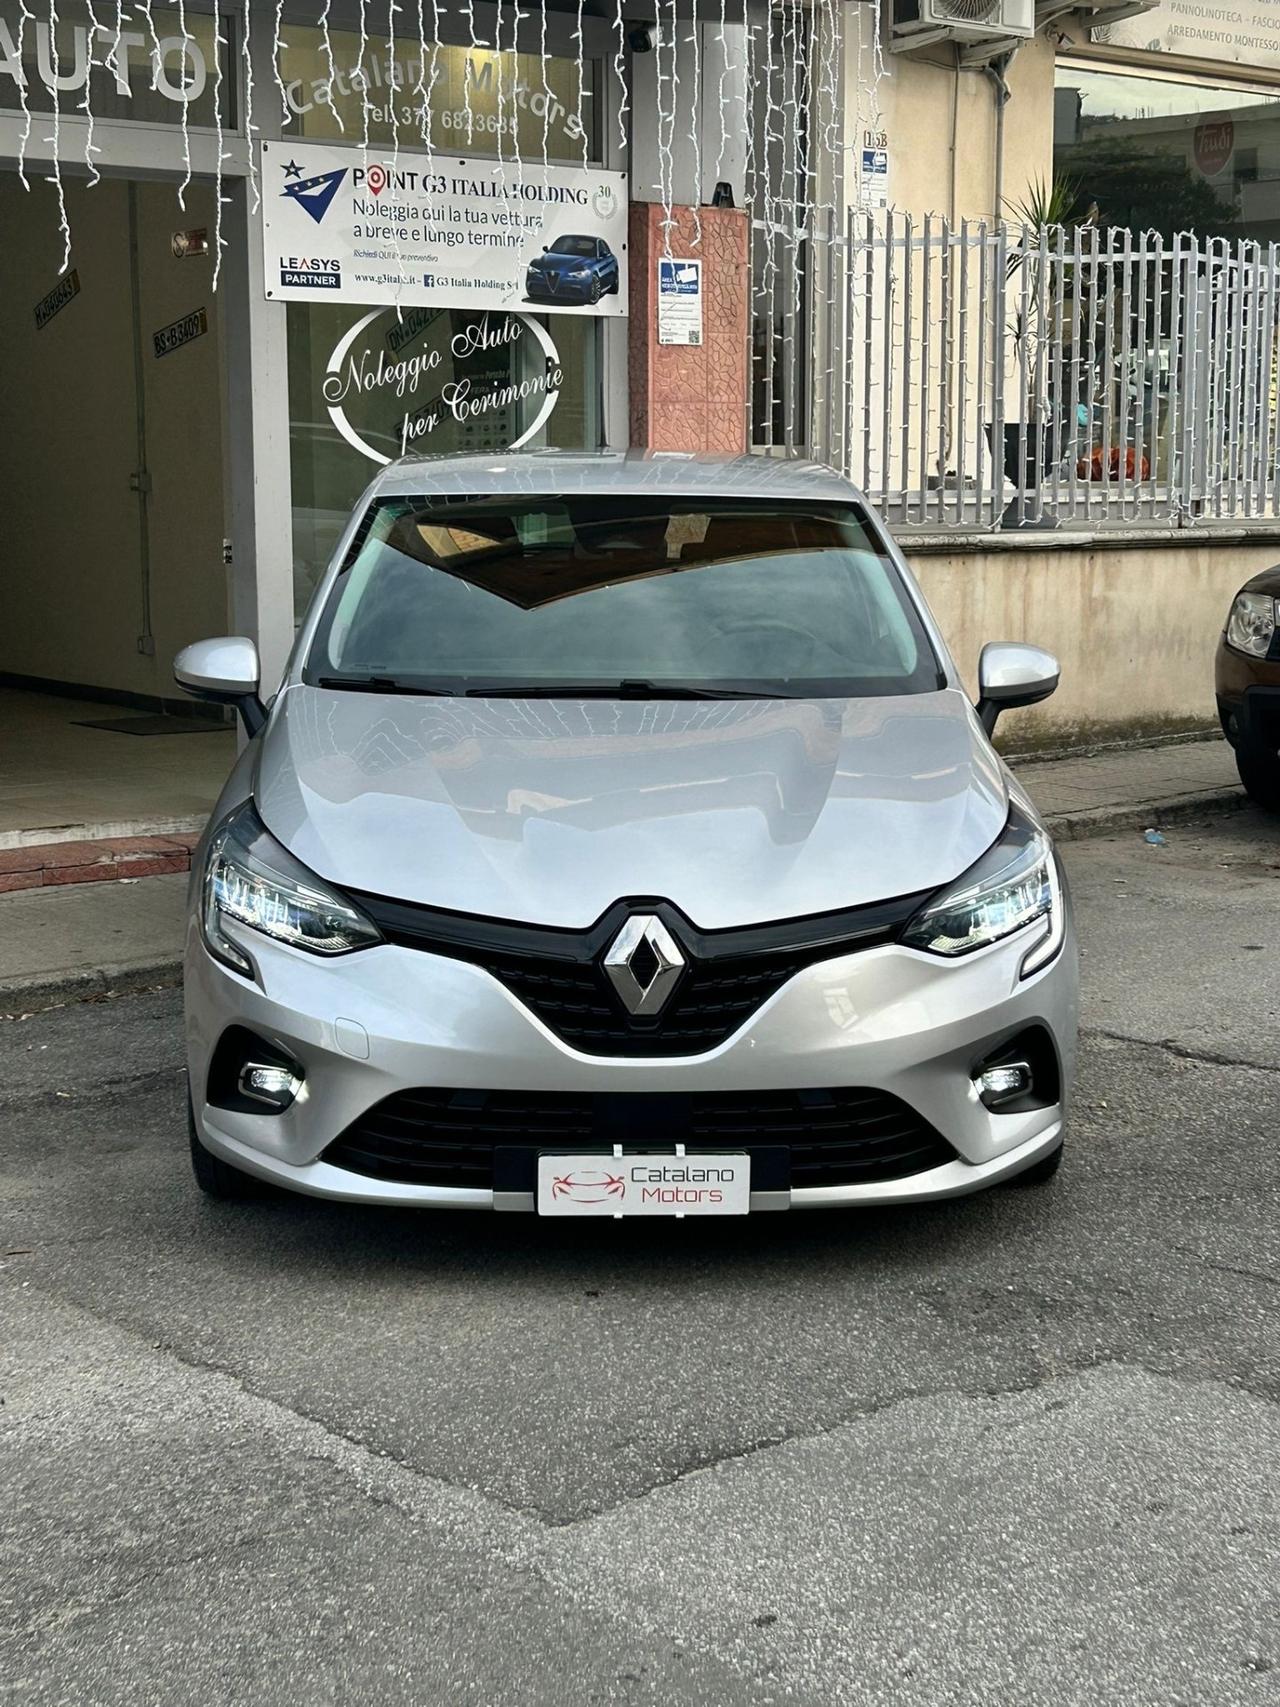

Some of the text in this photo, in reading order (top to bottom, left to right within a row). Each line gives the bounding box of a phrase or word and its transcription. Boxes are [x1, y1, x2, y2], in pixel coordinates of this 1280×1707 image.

[1170, 3, 1242, 23] PANNOLINOTECA
[1167, 23, 1280, 51] ARREDAMENTO MONTESSO
[353, 165, 588, 205] POINT G3 ITALIA HOLDING
[598, 185, 611, 198] 30
[353, 198, 419, 222] Noleggia
[449, 205, 461, 222] la
[464, 208, 488, 224] tua
[491, 211, 543, 228] vettura
[353, 224, 524, 248] a breve e lungo termine
[280, 256, 341, 271] LEASYS
[285, 274, 336, 286] PARTNER
[436, 277, 449, 287] G3
[451, 277, 472, 288] Italia
[474, 279, 505, 291] Holding
[322, 310, 523, 402] Noleggio Auto
[401, 412, 439, 456] per
[442, 361, 564, 423] Cerimonie
[631, 1166, 735, 1183] Catalano
[642, 1186, 723, 1203] Motors
